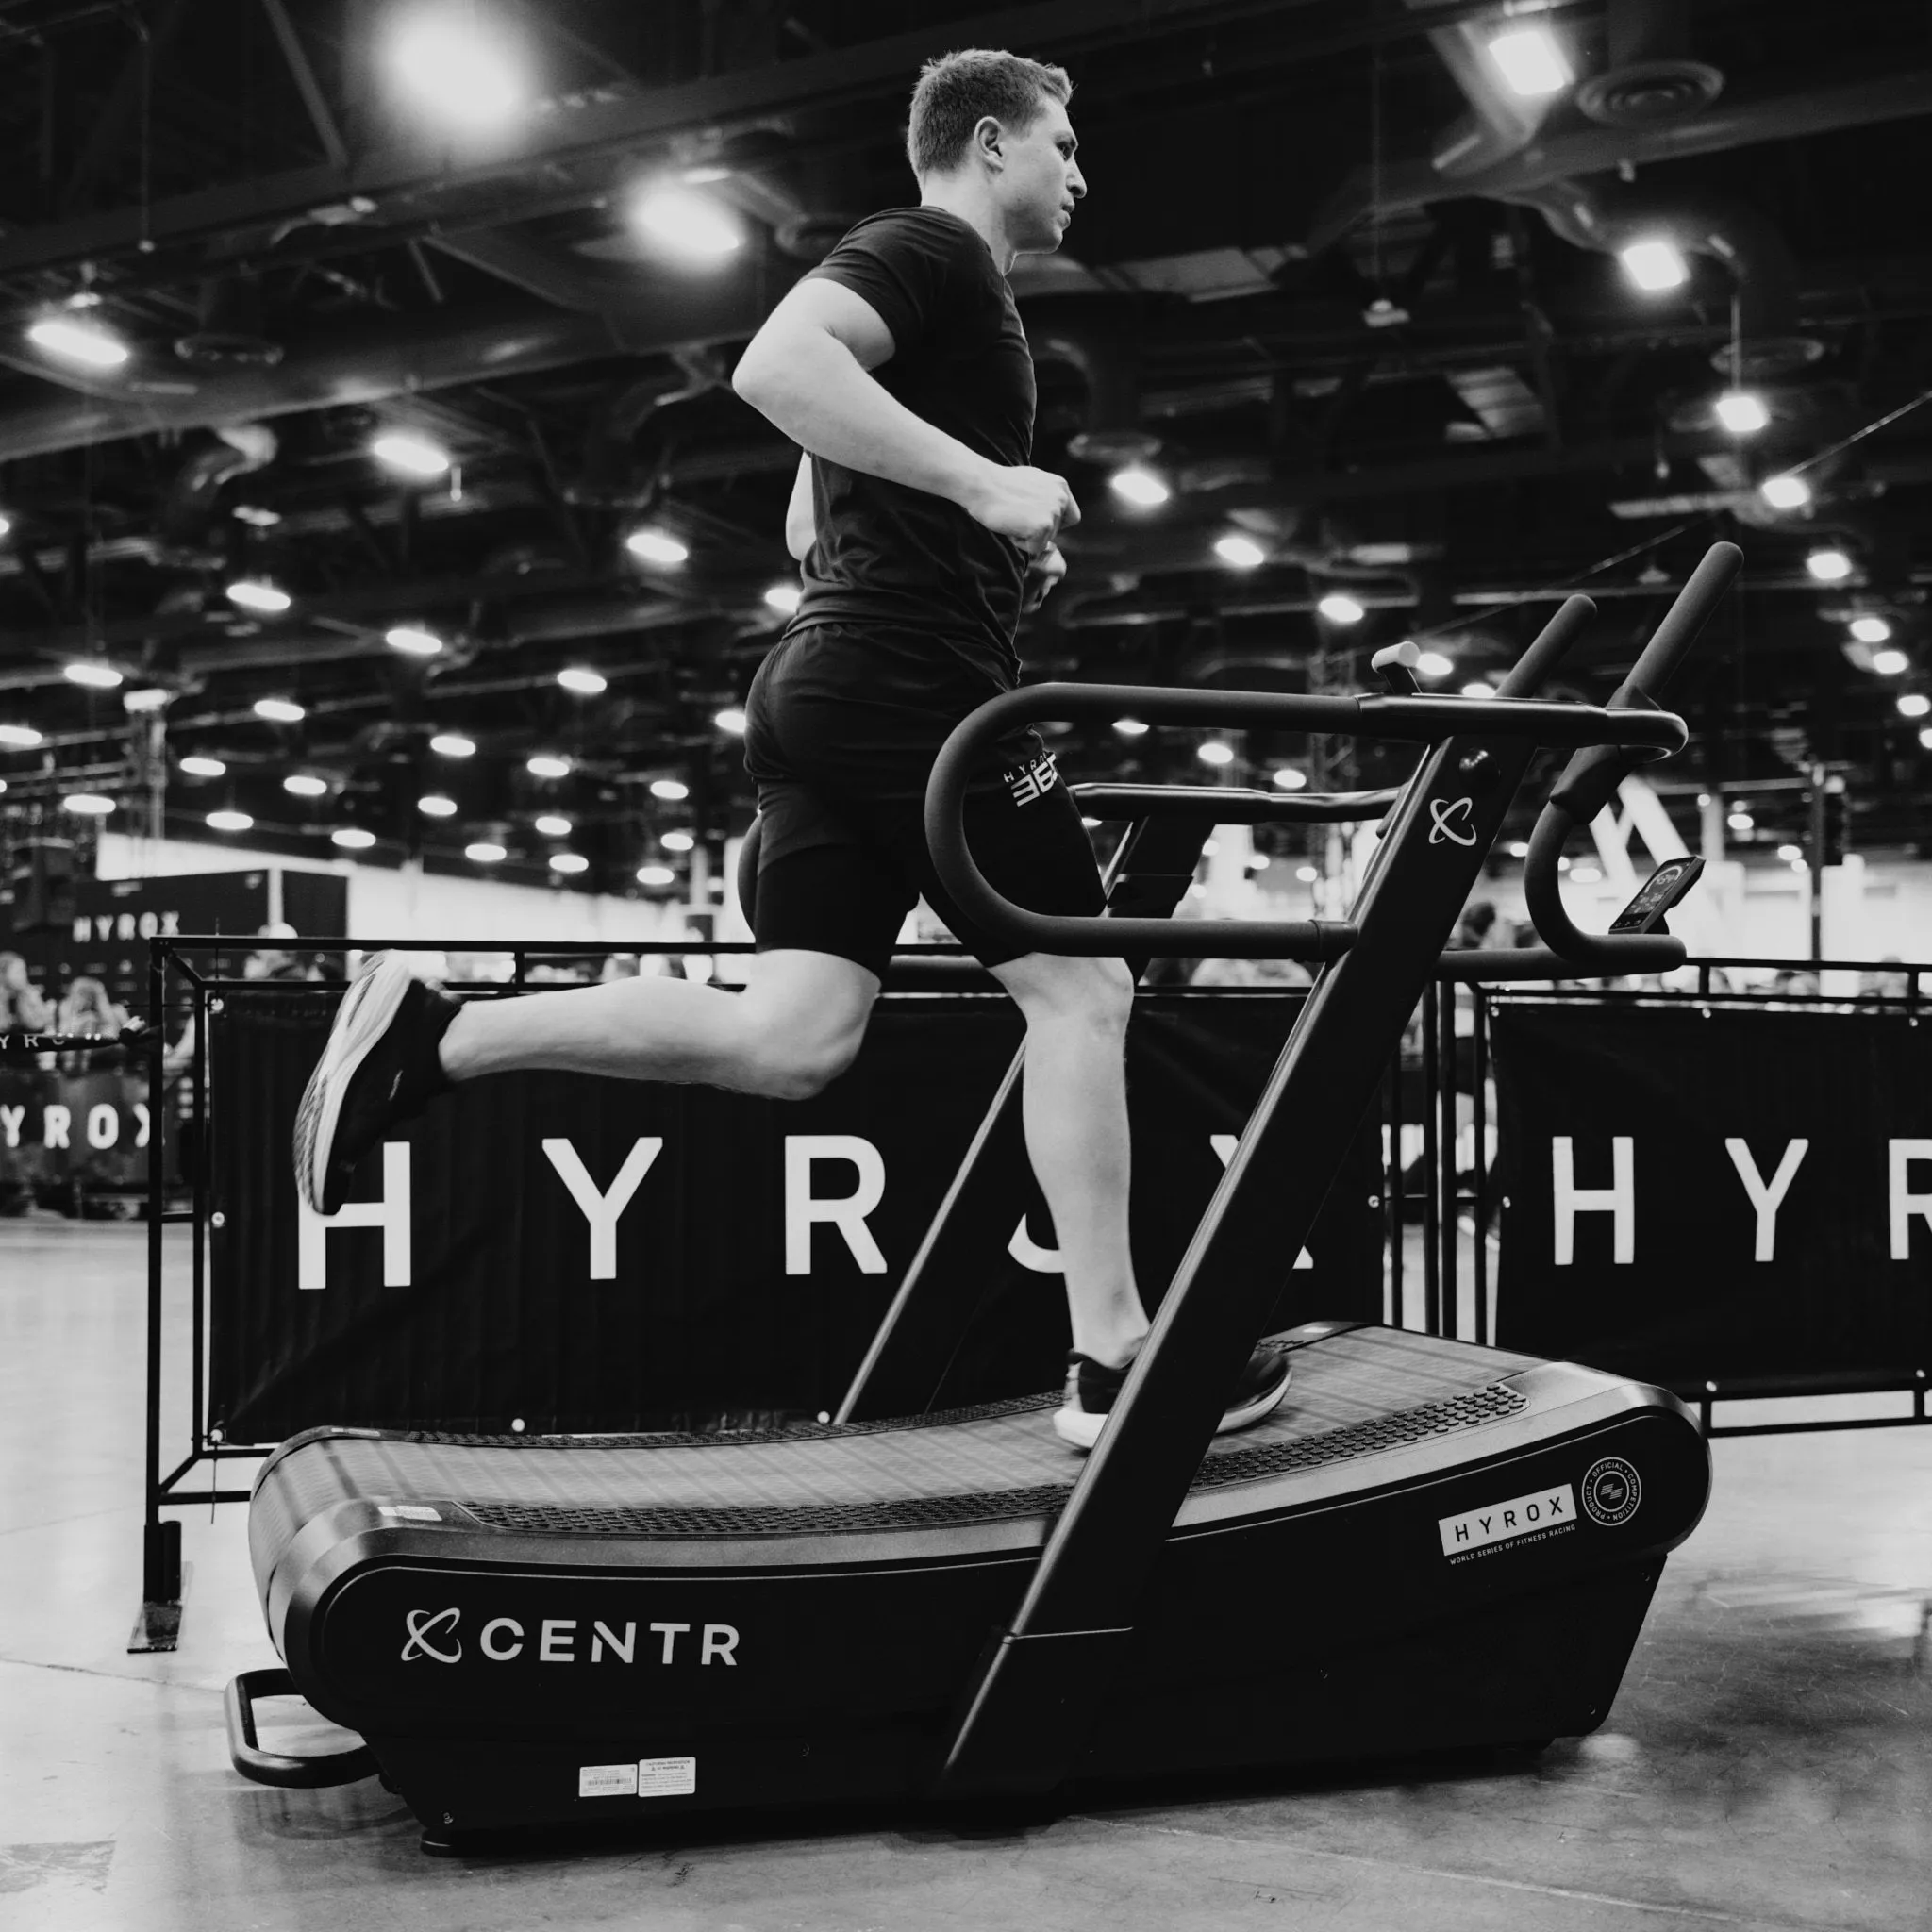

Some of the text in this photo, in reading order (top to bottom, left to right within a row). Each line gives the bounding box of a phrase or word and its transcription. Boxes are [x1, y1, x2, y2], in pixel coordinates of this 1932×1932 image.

[73, 910, 180, 942] HYROX
[298, 1134, 1314, 1290] HYR
[1586, 1461, 1638, 1521] OFFICIAL COMPETITION PRODUCT
[1455, 1496, 1563, 1542] HYROX
[1449, 1524, 1576, 1566] WORLD SERIES OF FITNESS RACING
[479, 1617, 740, 1666] CENTR
